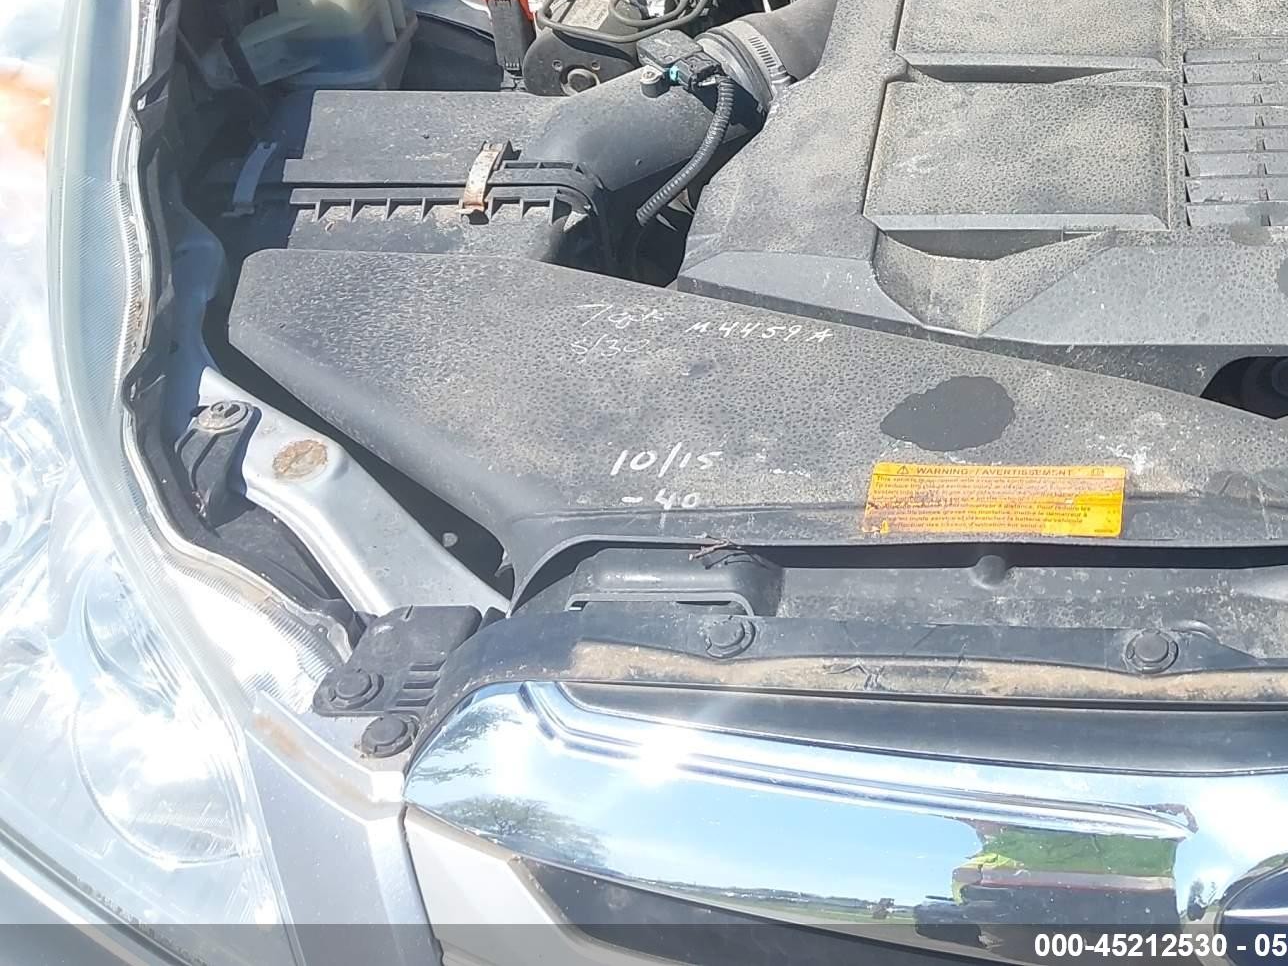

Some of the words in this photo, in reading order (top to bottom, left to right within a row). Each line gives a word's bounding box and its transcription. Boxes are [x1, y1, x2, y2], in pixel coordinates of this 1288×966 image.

[610, 441, 723, 478] 10/15
[916, 467, 969, 476] WARNING
[982, 468, 1072, 476] AVERTISSEMENT
